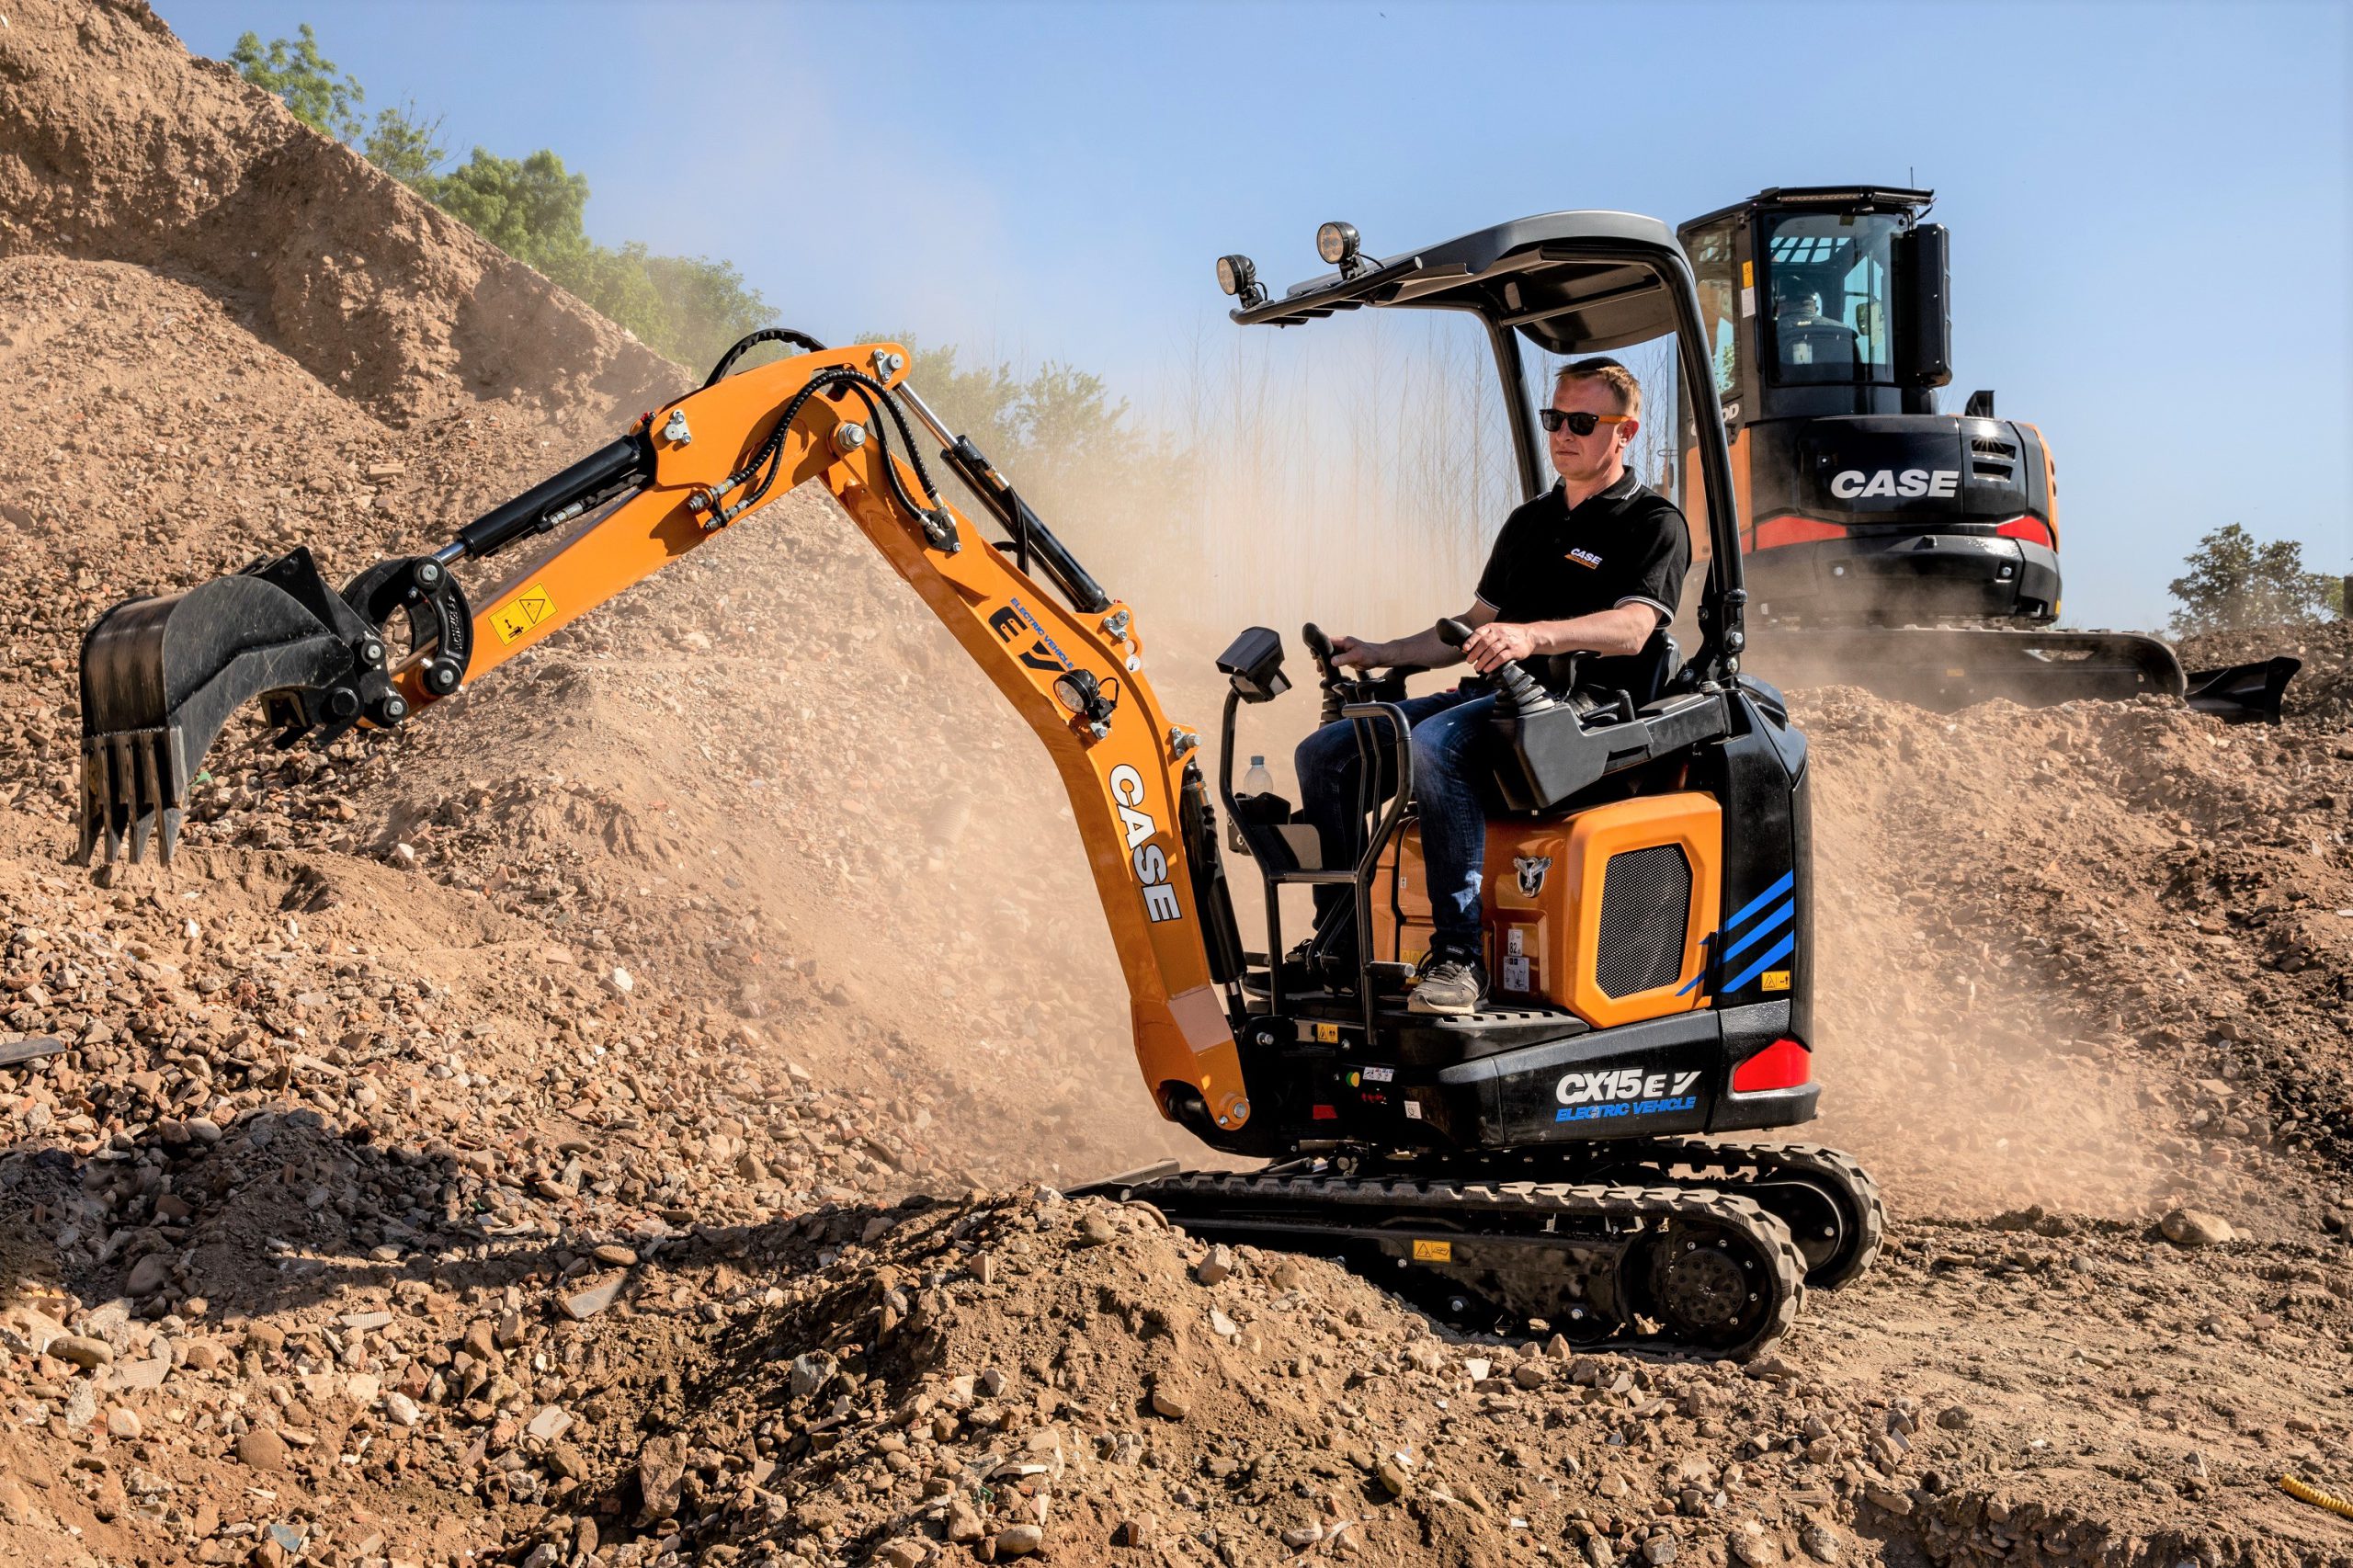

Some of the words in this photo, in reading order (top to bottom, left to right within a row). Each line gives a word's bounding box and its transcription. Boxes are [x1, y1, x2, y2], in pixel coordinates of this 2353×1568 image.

[1830, 469, 1960, 499] CASE
[1571, 548, 1603, 565] CASE
[1010, 597, 1045, 636] ELECTRIC
[1044, 635, 1074, 670] VEHICLE
[1109, 764, 1183, 923] CASE
[1509, 942, 1518, 954] 82
[1555, 1104, 1631, 1123] ELECTRIC
[1632, 1096, 1697, 1116] VEHICLE
